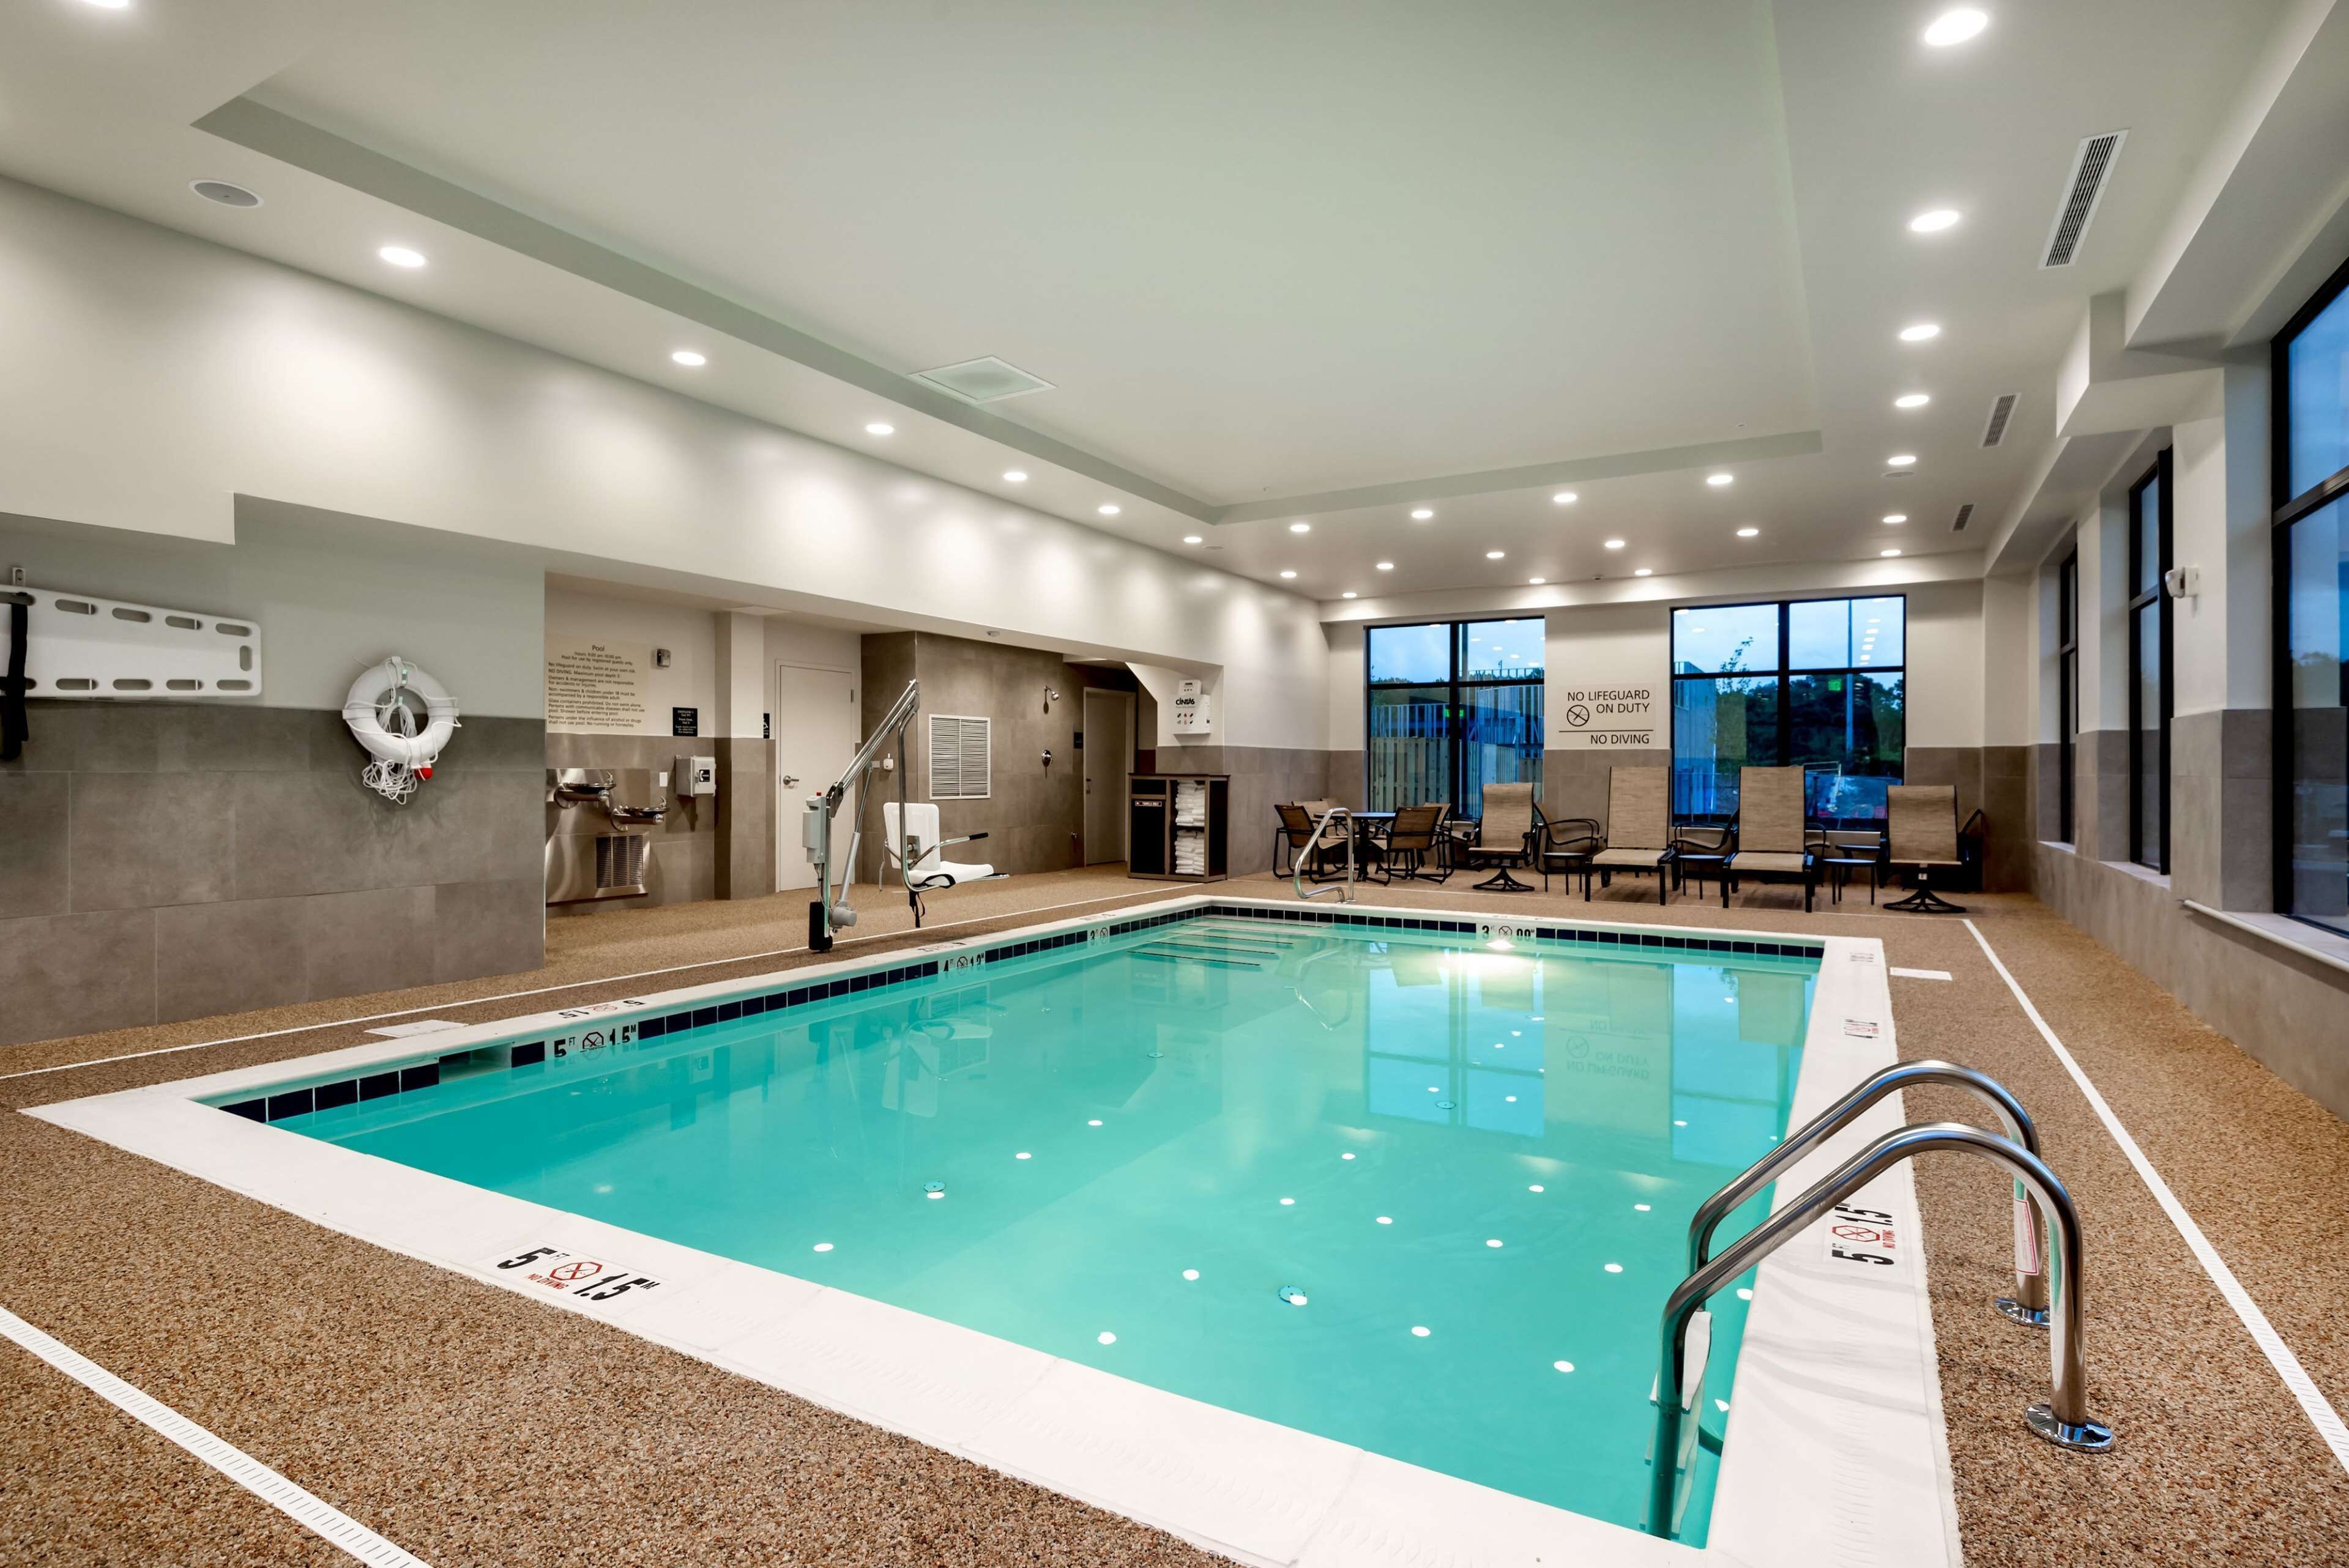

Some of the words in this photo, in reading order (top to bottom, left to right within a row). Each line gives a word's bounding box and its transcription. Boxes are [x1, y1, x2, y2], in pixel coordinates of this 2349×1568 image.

[1568, 691, 1584, 701] NO
[1588, 690, 1650, 701] LIFEGUARD
[1596, 704, 1614, 713] ON
[1618, 702, 1650, 713] DUTY
[1591, 734, 1607, 744] NO
[1611, 734, 1649, 744] DIVING
[554, 1039, 567, 1057] 5
[569, 1036, 576, 1046] FT
[497, 1247, 557, 1269] 5
[1832, 1249, 1894, 1265] 5
[537, 1277, 569, 1290] DIVING
